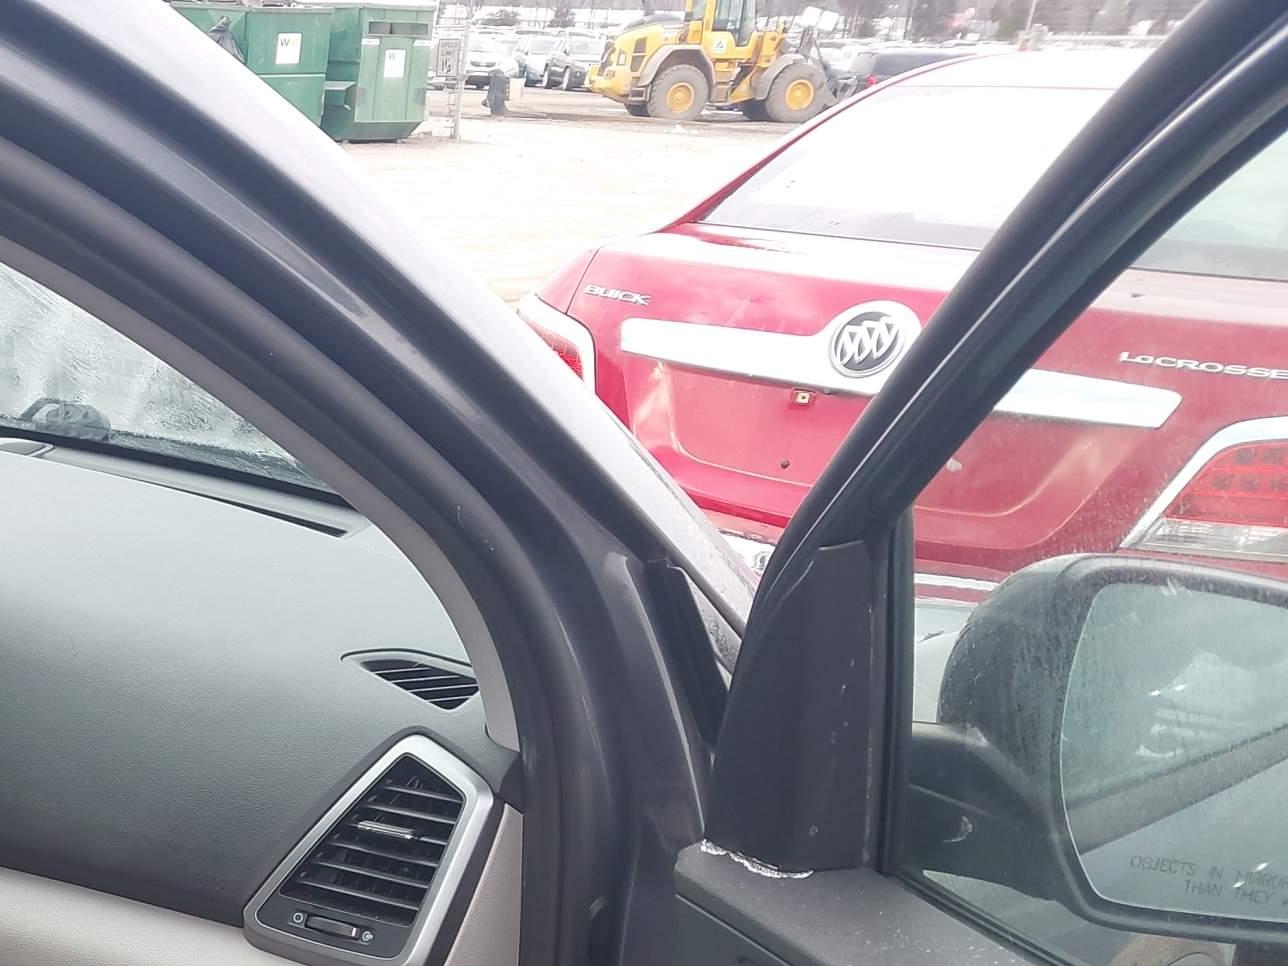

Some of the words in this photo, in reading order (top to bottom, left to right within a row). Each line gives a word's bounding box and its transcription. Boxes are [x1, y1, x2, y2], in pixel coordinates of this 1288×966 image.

[584, 283, 653, 306] BUICK
[1130, 855, 1198, 876] OBJECTS
[1208, 865, 1224, 881] IN
[1184, 879, 1224, 897] THAN
[1233, 887, 1272, 905] THEY
